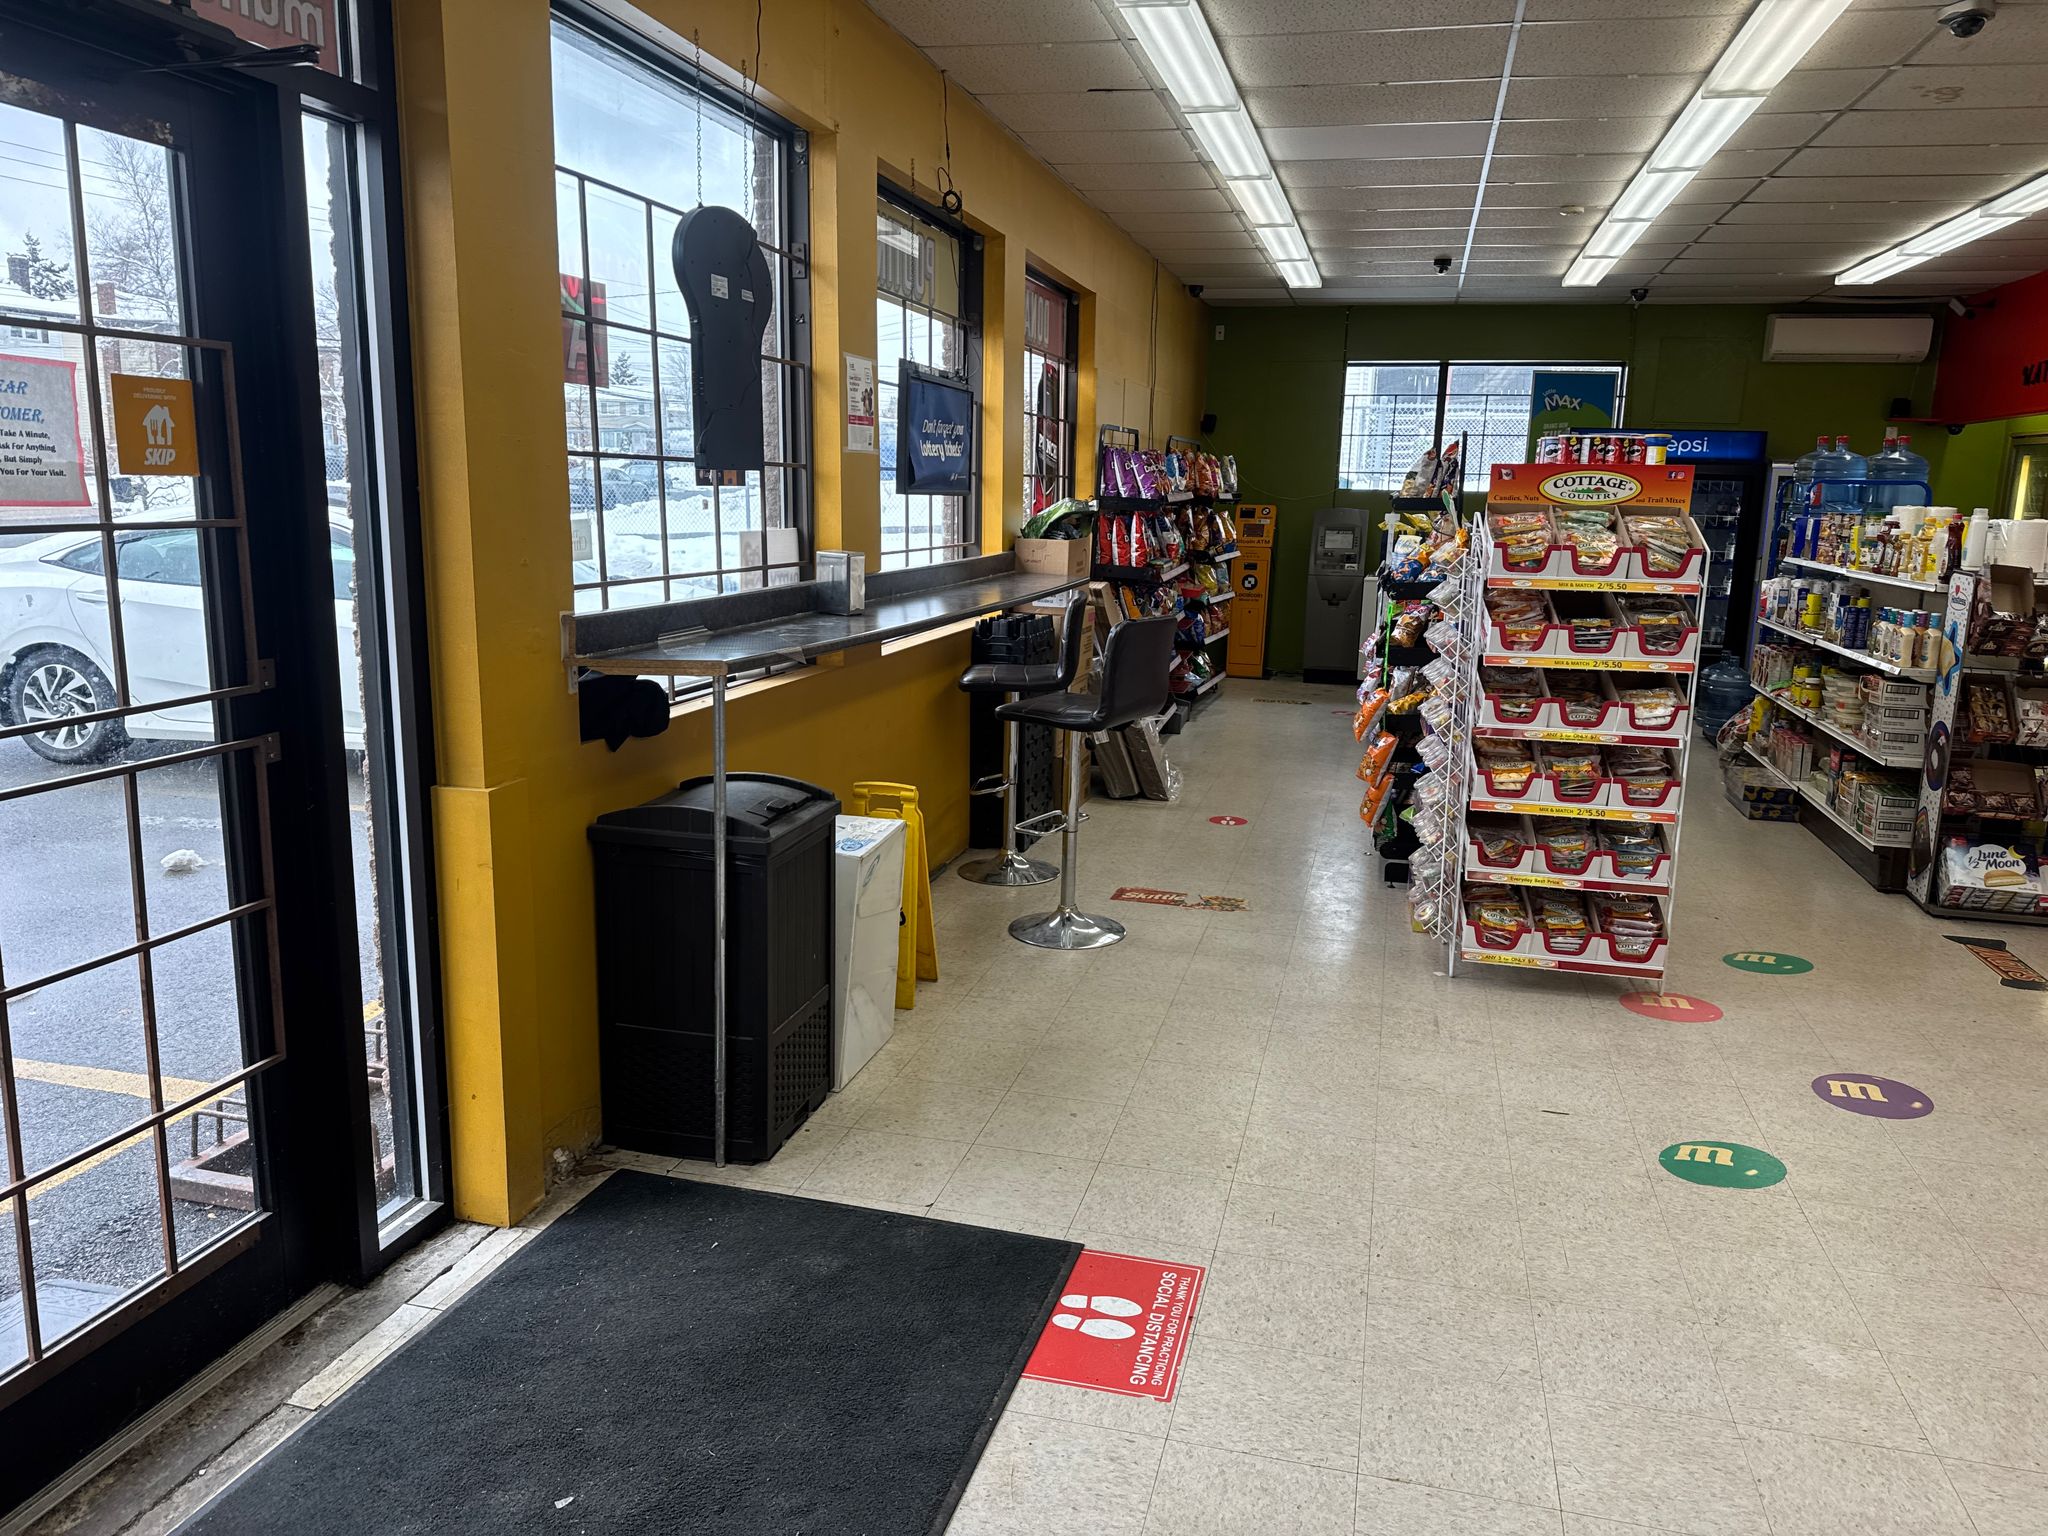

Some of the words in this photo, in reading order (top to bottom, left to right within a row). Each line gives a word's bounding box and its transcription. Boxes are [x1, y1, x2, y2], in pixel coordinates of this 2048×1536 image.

[1545, 394, 1581, 411] MAX
[0, 406, 45, 424] OMER,
[0, 428, 17, 437] Take
[19, 429, 24, 437] A
[25, 430, 50, 440] Minute,
[922, 419, 936, 433] Don't
[935, 419, 954, 439] forget
[12, 442, 24, 450] For
[26, 443, 56, 453] Anything
[920, 439, 945, 462] lottery
[1666, 436, 1708, 456] epsi
[4, 455, 17, 463] But
[19, 455, 42, 465] Simply
[144, 448, 176, 466] SKIP
[16, 468, 29, 476] For
[31, 468, 48, 476] Your
[49, 469, 67, 477] Visit.
[1553, 475, 1628, 491] COTTAGE
[1493, 494, 1522, 502] Candies,
[1524, 494, 1540, 502] Nuts
[1560, 490, 1618, 501] COUNTRY
[1978, 849, 2007, 863] Lune
[1985, 858, 2021, 870] Moon
[1510, 876, 1533, 884] Everyday
[1732, 952, 1777, 965] m
[1826, 1079, 1889, 1103] m
[1673, 1144, 1734, 1167] m
[1151, 1271, 1177, 1310] SOCIAL
[1175, 1276, 1191, 1301] THANK
[1170, 1302, 1184, 1318] YOU
[1165, 1318, 1179, 1335] FOR
[1129, 1312, 1166, 1386] DISTANCING
[1150, 1335, 1175, 1386] PRACTICING
